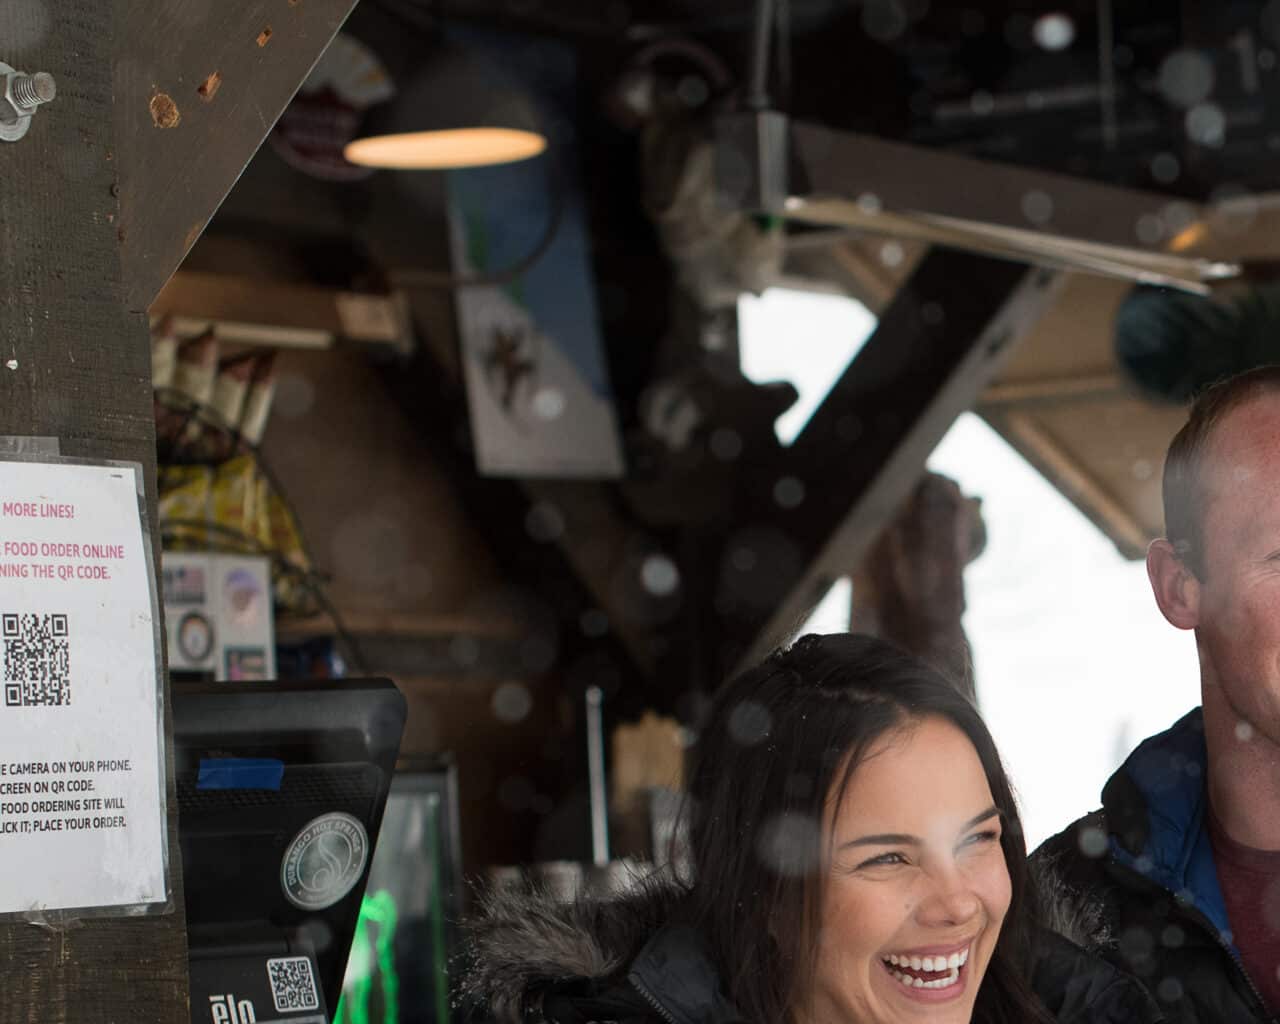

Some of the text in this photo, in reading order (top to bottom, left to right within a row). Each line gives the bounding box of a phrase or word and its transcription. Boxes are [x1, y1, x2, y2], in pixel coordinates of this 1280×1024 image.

[3, 502, 74, 519] MORE LINES!
[4, 542, 125, 559] FOOD ORDER ONLINE
[32, 564, 54, 579] THE
[57, 565, 74, 581] QR
[77, 565, 111, 580] CODE.
[9, 762, 49, 775] CAMERA
[52, 761, 66, 774] ON
[68, 760, 95, 773] YOUR
[97, 759, 132, 772] PHONE.
[34, 781, 48, 793] ON
[51, 780, 65, 794] QR
[67, 779, 95, 792] CODE.
[1, 797, 125, 815] FOOD ORDERING SITE WILL
[20, 820, 32, 834] IT;
[33, 819, 62, 832] PLACE
[64, 818, 91, 830] YOUR
[93, 816, 127, 828] ORDER.
[312, 822, 332, 835] HOT
